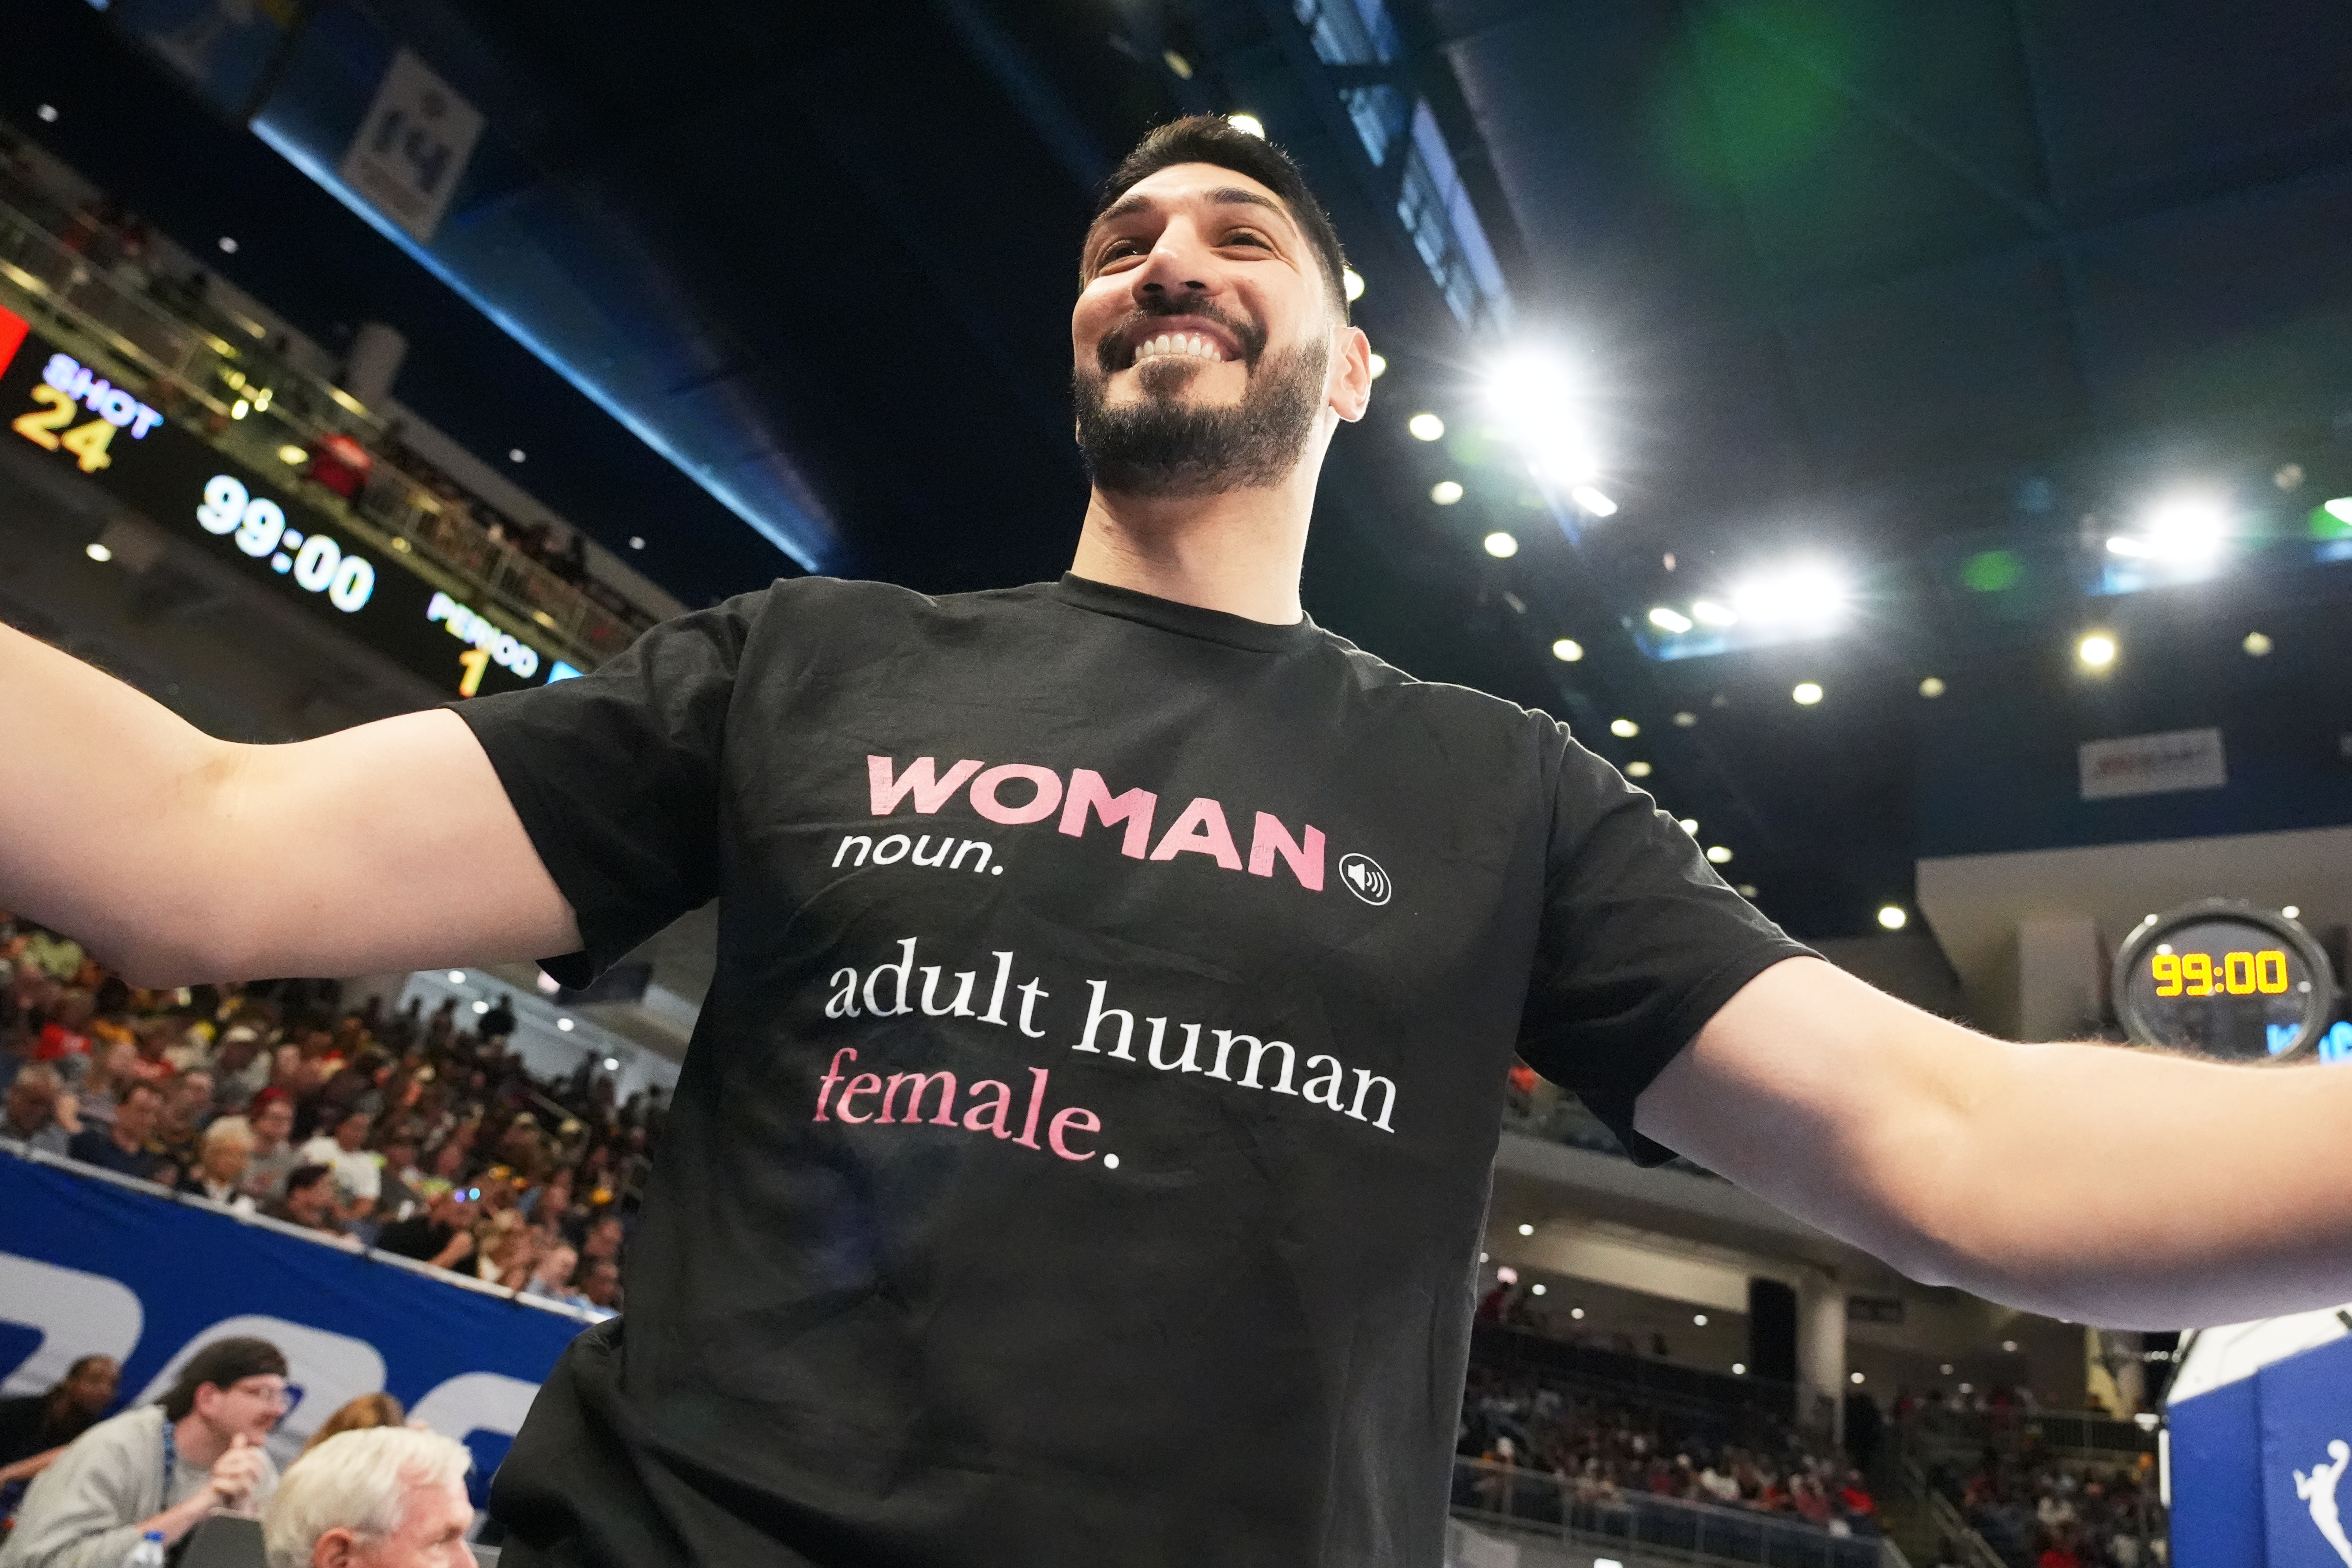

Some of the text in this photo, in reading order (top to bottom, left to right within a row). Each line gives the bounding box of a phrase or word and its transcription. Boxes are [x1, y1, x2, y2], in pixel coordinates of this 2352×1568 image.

[12, 383, 117, 473] 24
[42, 353, 164, 440] SHOT
[196, 475, 375, 613] 99:00
[459, 648, 491, 697] 1
[831, 834, 1004, 875] noun.
[867, 755, 1326, 891] WOMAN
[2151, 950, 2288, 997] 99:00
[825, 936, 1396, 1133] adult human
[812, 1048, 1120, 1169] female.
